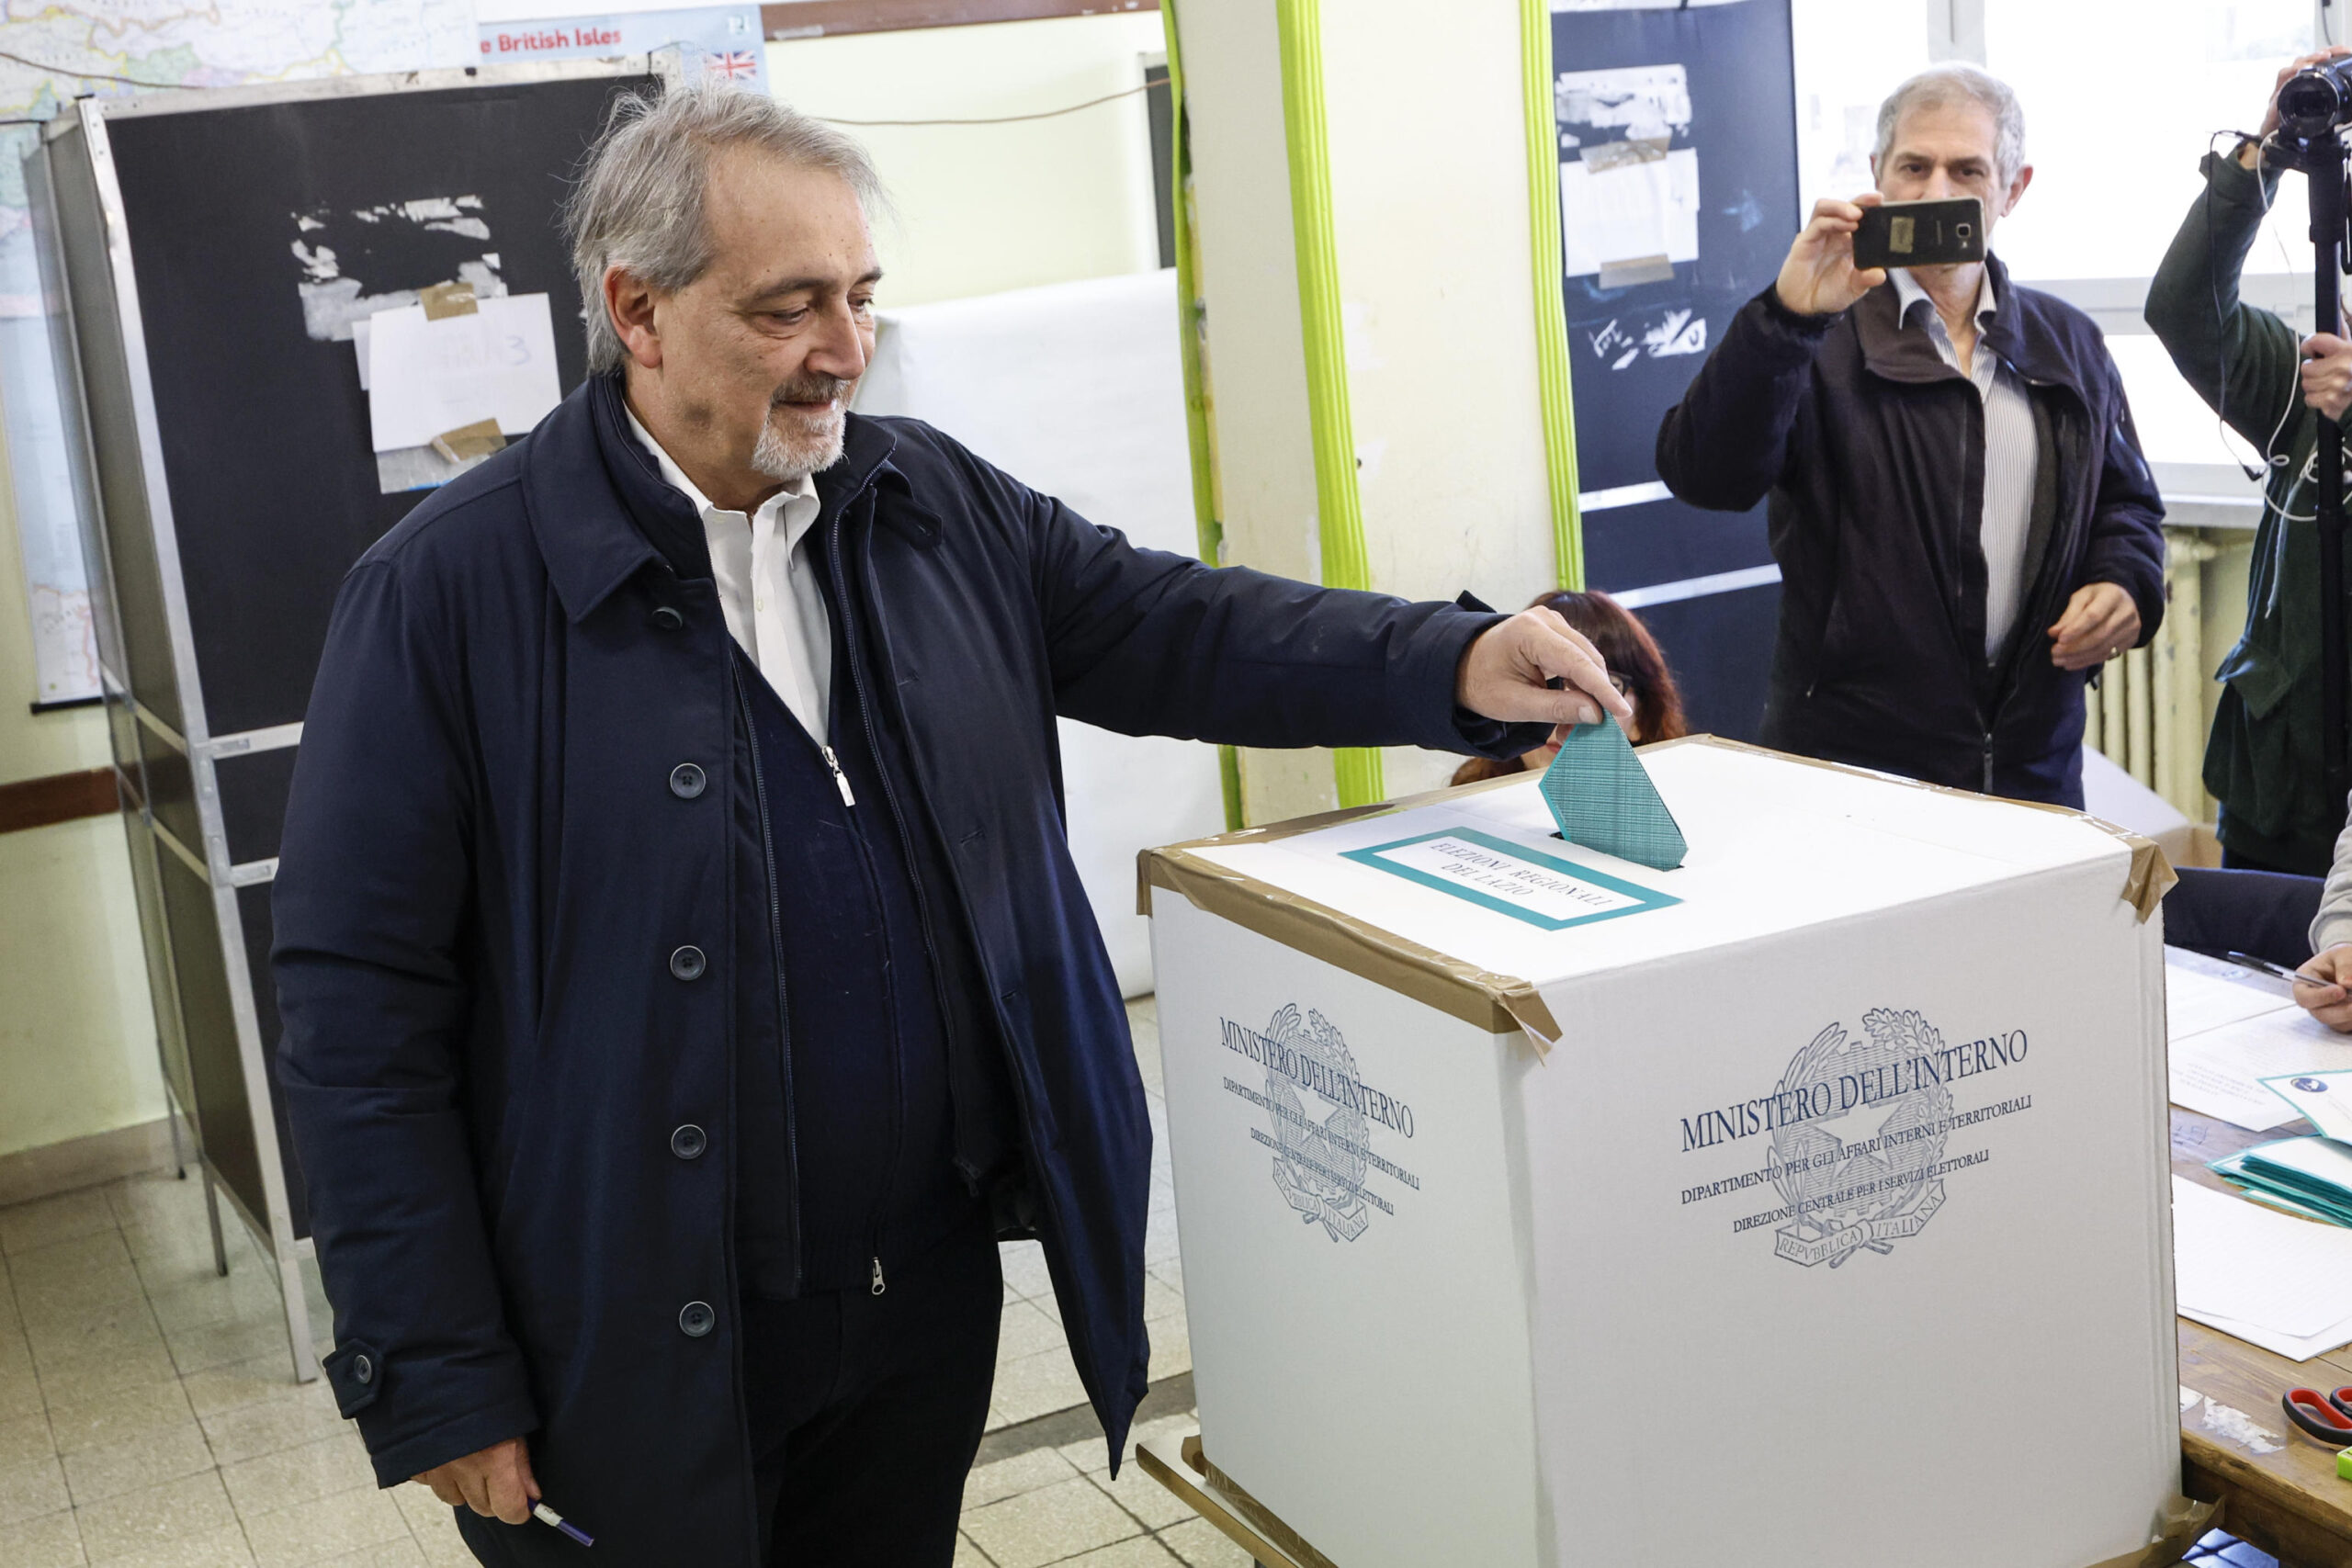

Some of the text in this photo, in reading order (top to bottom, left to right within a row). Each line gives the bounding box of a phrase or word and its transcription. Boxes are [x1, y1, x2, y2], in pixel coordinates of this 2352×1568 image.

[498, 29, 570, 51] British
[575, 28, 622, 47] Isles
[1430, 841, 1613, 907] ELEZIONI REGIONALI
[1441, 862, 1534, 896] DEL LAZIO
[1220, 1017, 1414, 1138] MINISTERO DELL'INTERNO
[1680, 1029, 2028, 1153] MINISTERO DELL'INTERNO
[1223, 1076, 1275, 1112] DIPARTIMENTO
[1304, 1117, 1328, 1141] AFFARI
[1328, 1130, 1360, 1158] INTERNI
[1366, 1151, 1420, 1191] TERRITORIALI
[1250, 1126, 1283, 1155] DIREZIONE
[1355, 1183, 1395, 1217] ELETTORALI
[1680, 1094, 2032, 1205] DIPARTIMENTO PER GLI AFFARI INTERNI E TERRITORIALI
[1327, 1206, 1366, 1238] ITALIANA
[1733, 1204, 1795, 1233] DIREZIONE
[1797, 1189, 1855, 1215] CENTRALE
[1856, 1182, 1876, 1199] PER
[1884, 1168, 1925, 1190] SERVIZI
[1927, 1149, 1990, 1179] ELETTORALI
[1778, 1195, 1942, 1261] REPVBBLICA ITALIANA
